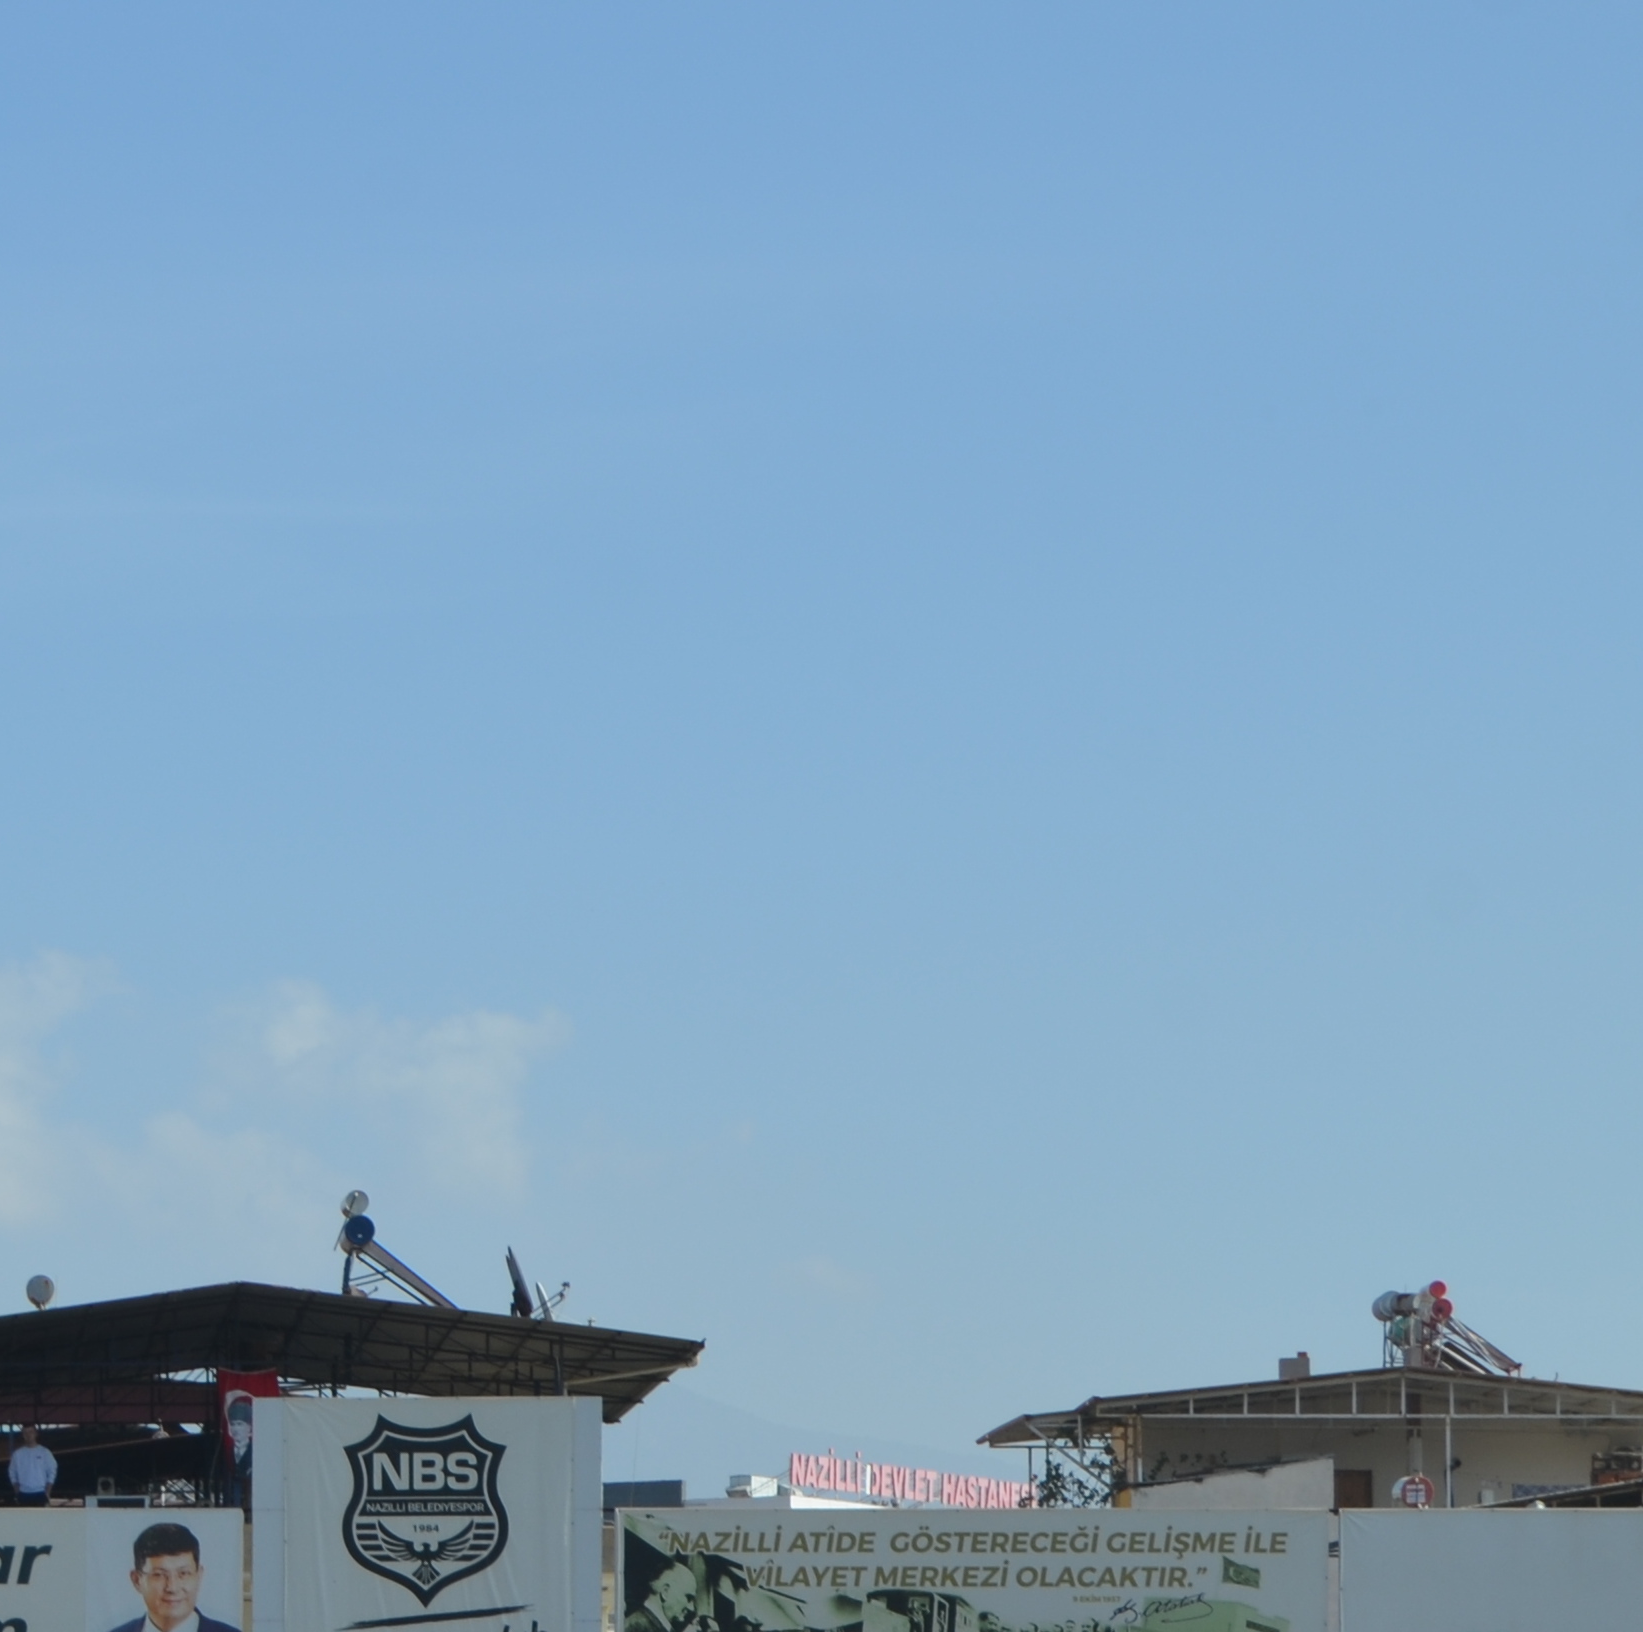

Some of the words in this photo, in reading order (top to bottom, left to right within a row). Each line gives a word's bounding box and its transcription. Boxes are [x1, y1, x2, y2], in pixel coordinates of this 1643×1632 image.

[373, 1451, 478, 1491] NBS
[790, 1447, 863, 1493] NAZİLLİ
[412, 1524, 440, 1534] 1984
[890, 1524, 1101, 1554] GÖSTERECEĞİ
[1106, 1525, 1237, 1559] GELİŞME
[1244, 1525, 1289, 1554] İLE
[873, 1560, 1010, 1588] MERKEZİ
